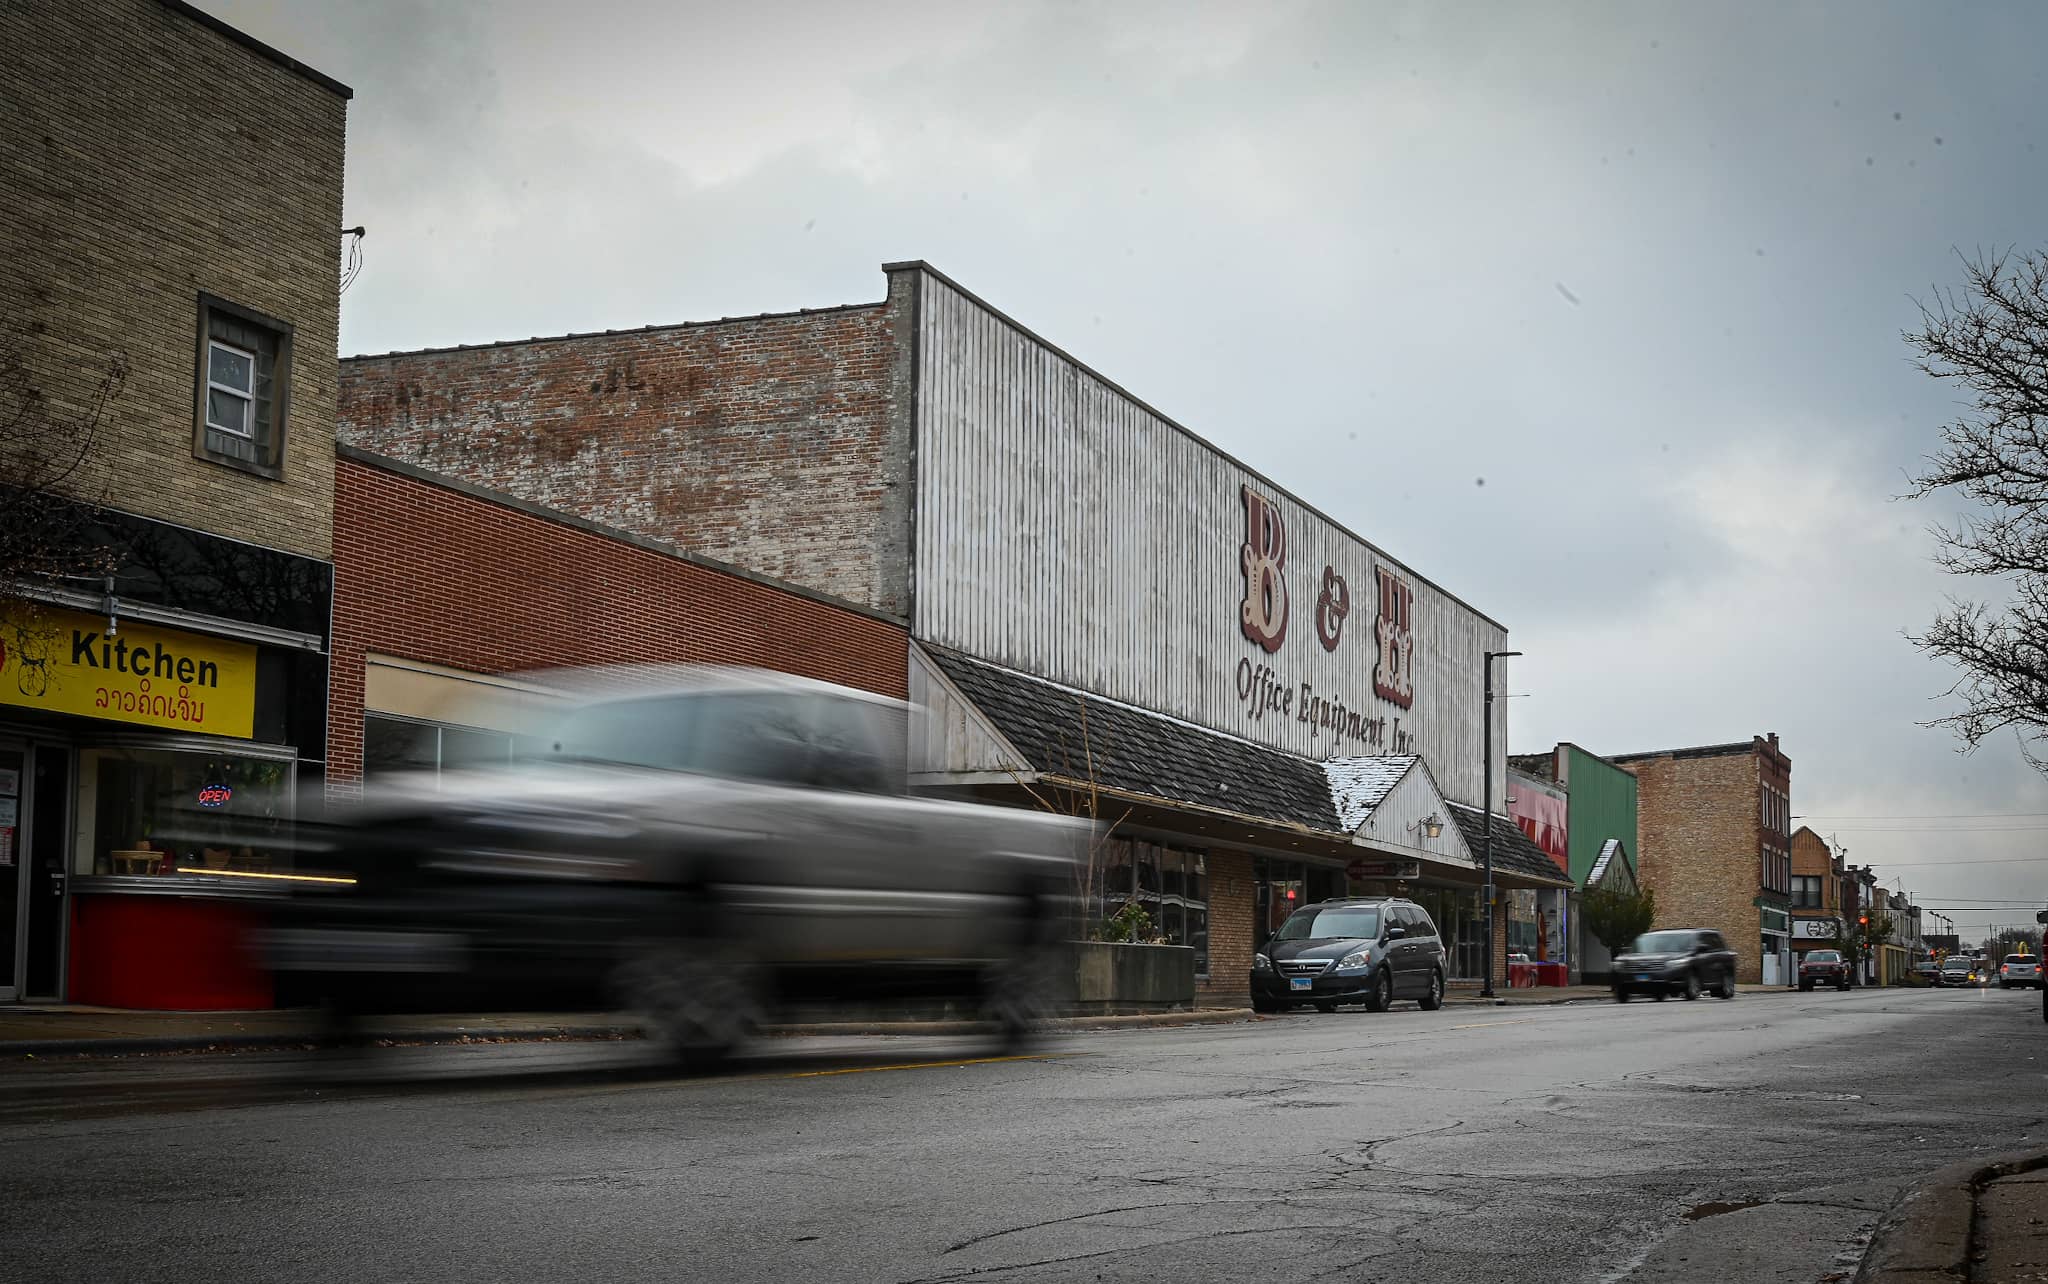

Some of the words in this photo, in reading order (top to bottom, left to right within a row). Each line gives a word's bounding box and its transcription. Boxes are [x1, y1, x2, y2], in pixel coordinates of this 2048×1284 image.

[1241, 484, 1289, 653] B
[1316, 565, 1350, 653] &
[1374, 564, 1414, 710] H
[72, 630, 218, 688] Kitchen
[1237, 657, 1293, 720] Office
[198, 790, 233, 802] OPEN
